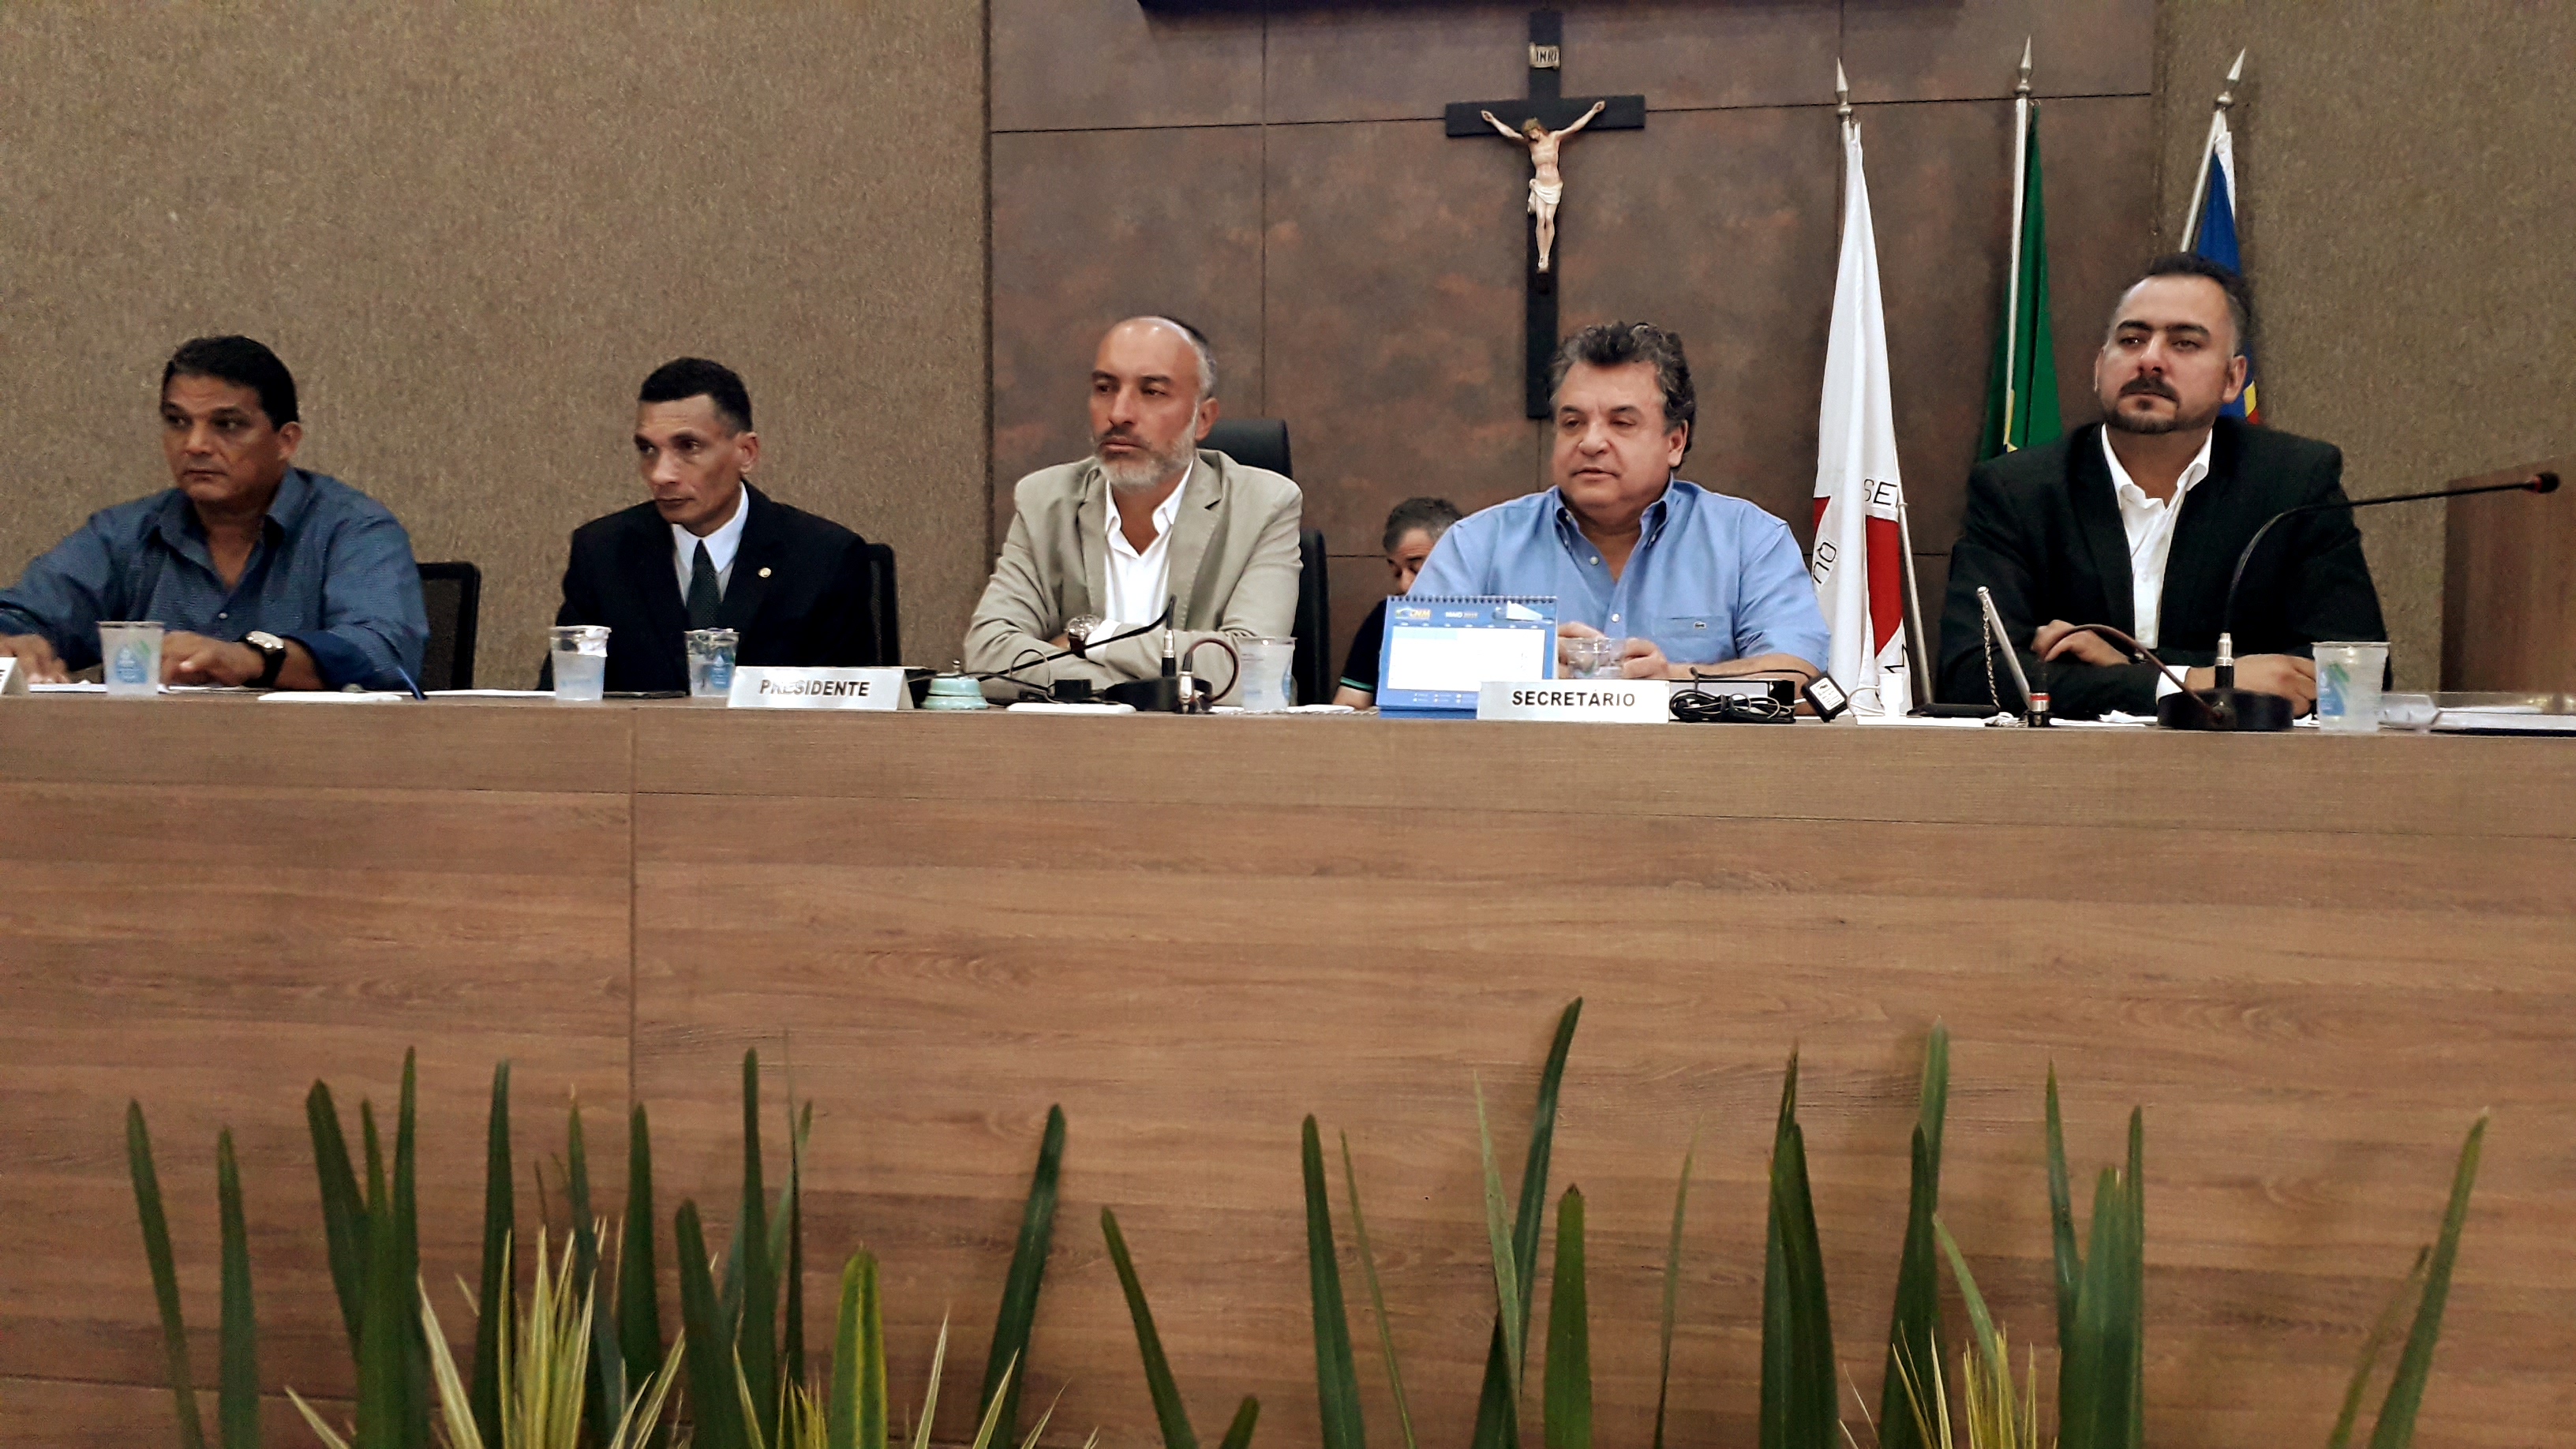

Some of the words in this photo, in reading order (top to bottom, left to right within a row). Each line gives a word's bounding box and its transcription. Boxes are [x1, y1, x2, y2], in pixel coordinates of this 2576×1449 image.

[1536, 51, 1557, 62] INRI
[1864, 478, 1899, 508] SE
[759, 679, 871, 697] PRESIDENTE
[1511, 689, 1635, 707] SECRETÁRIO
